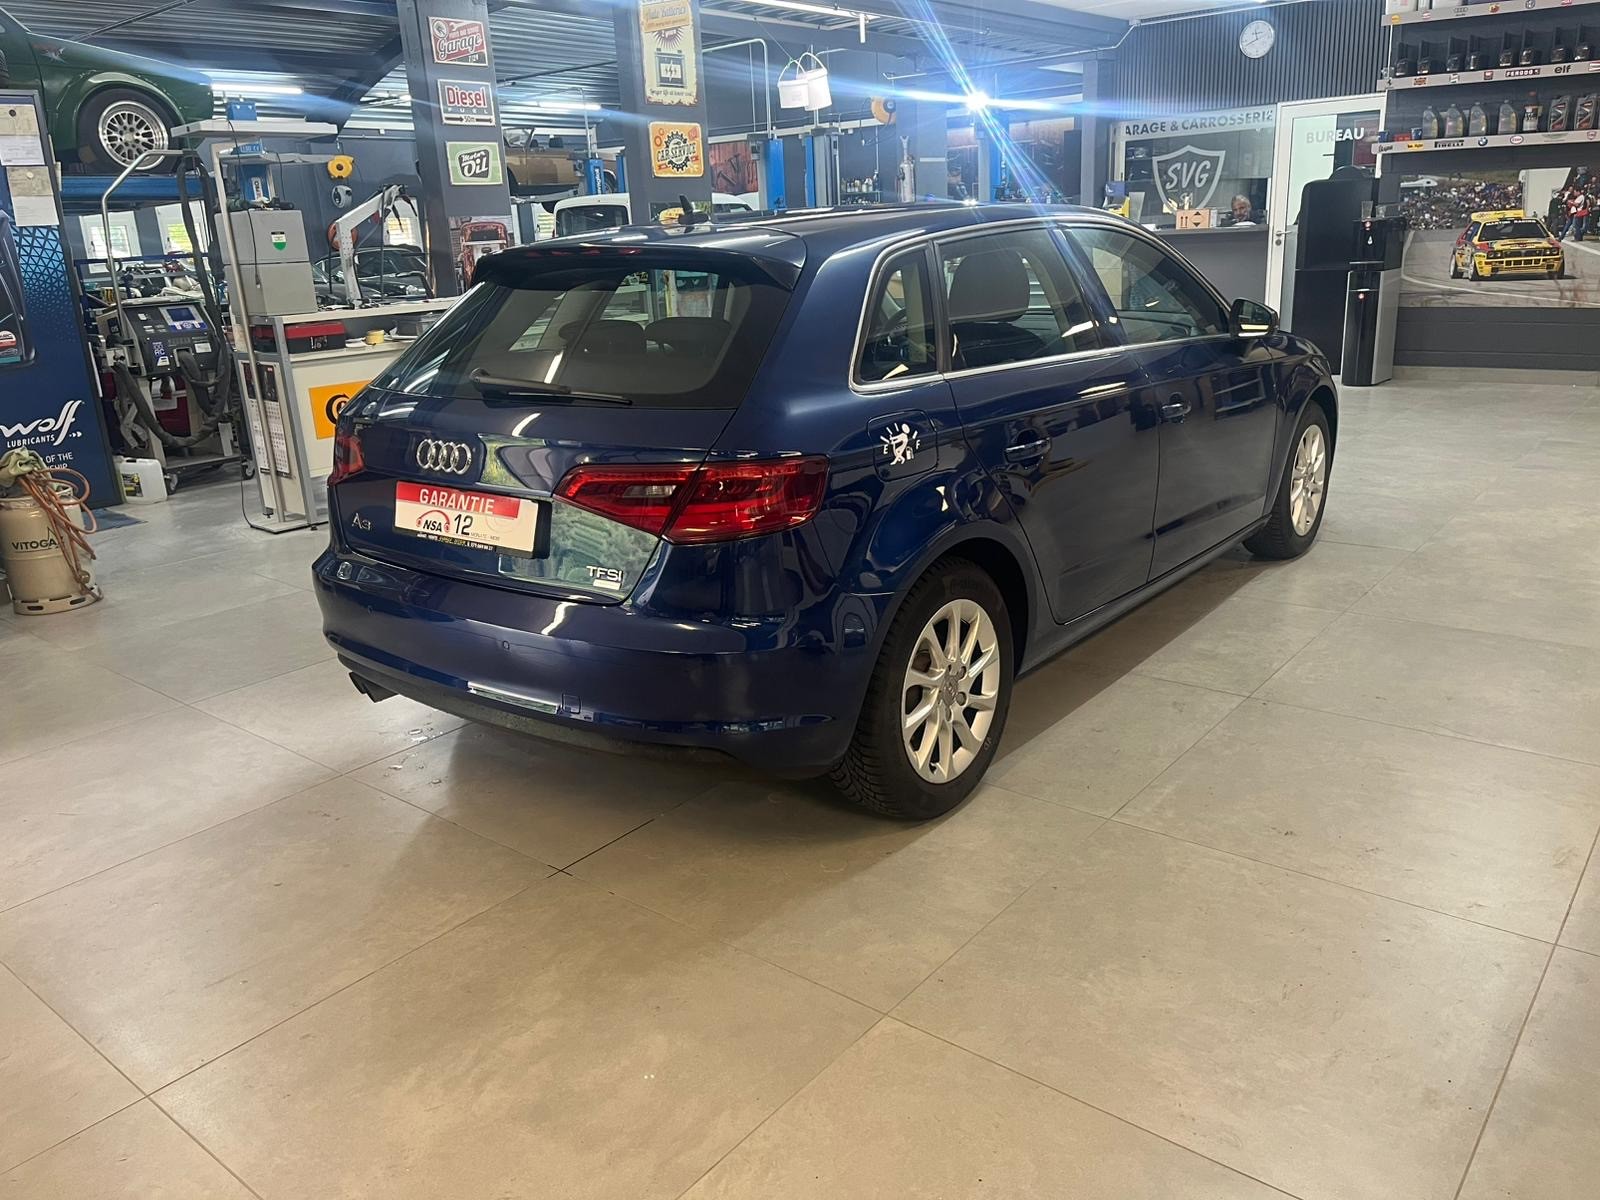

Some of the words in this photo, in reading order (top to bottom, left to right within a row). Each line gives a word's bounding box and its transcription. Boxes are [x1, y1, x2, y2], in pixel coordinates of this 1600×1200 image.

[437, 34, 482, 60] Garage
[1554, 65, 1571, 74] elf
[445, 86, 487, 108] Diesel
[1170, 120, 1179, 132] &
[1306, 127, 1365, 144] BUREAU
[669, 142, 696, 160] SERVICE
[1166, 159, 1211, 189] SVG
[7, 434, 55, 448] LUBRICANTS
[45, 454, 56, 463] OF
[57, 451, 74, 461] THE
[419, 487, 495, 515] GARANTIE
[351, 512, 371, 530] A3
[422, 519, 442, 532] NSA
[454, 513, 474, 536] 12
[12, 538, 63, 550] VITOGA
[586, 565, 623, 582] TFSI
